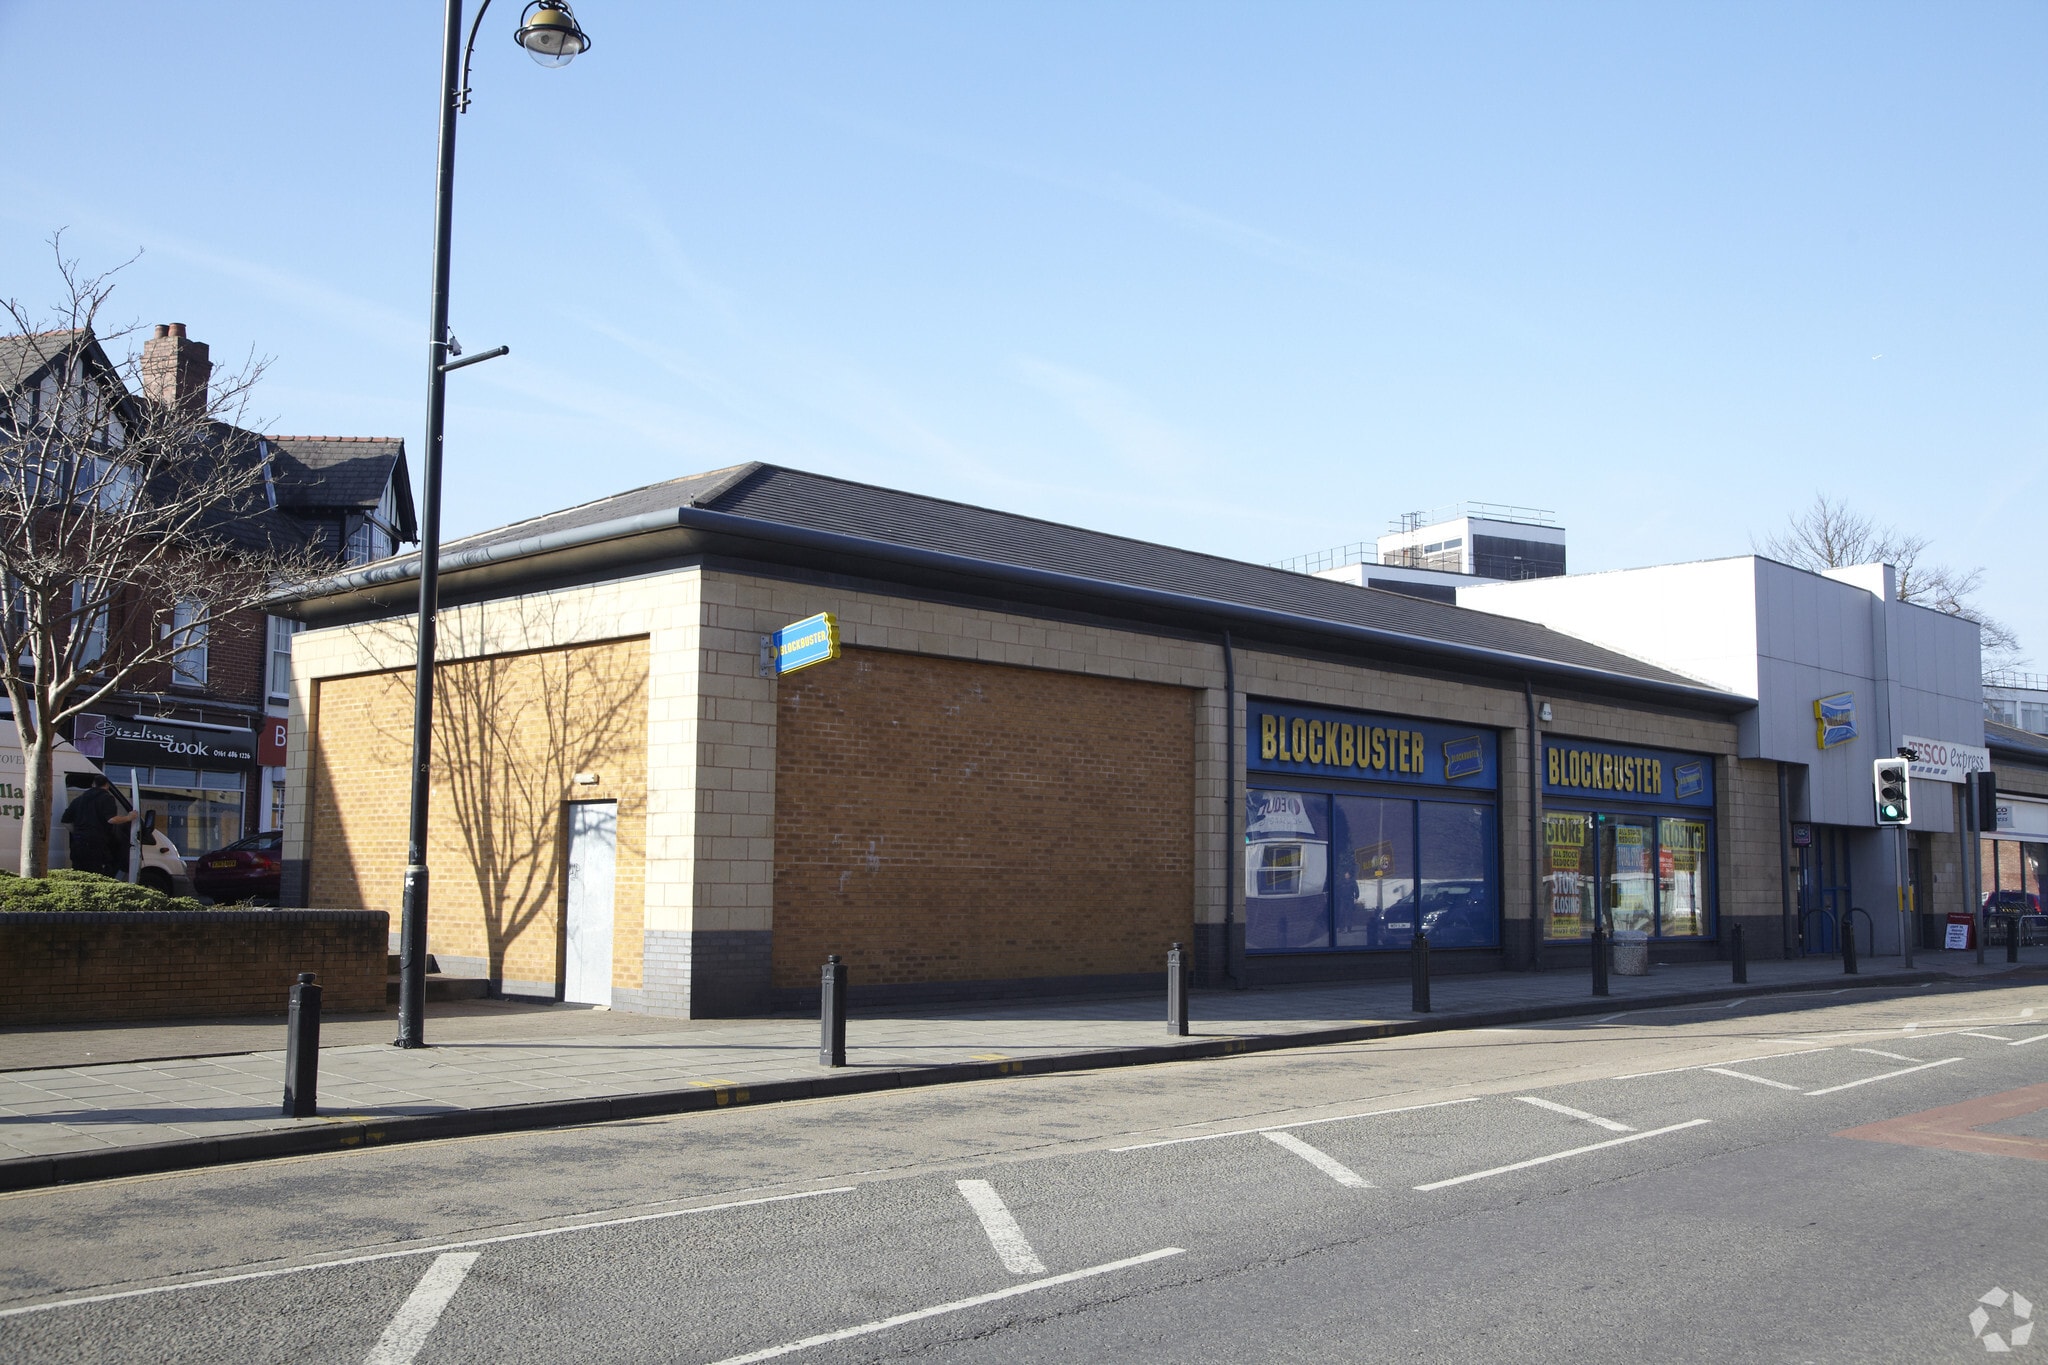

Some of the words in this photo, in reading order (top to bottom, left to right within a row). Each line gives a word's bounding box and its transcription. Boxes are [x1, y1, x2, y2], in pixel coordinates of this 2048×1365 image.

[780, 630, 827, 655] BLOCKBUSTER
[84, 720, 175, 748] Sizzling
[1261, 713, 1425, 774] BLOCKBUSTER
[1548, 747, 1662, 794] BLOCKBUSTER
[1950, 748, 1984, 775] express
[1547, 817, 1581, 844] STORE
[1663, 822, 1704, 850] CLOSING!
[1552, 871, 1580, 895] STORE
[1553, 896, 1580, 914] CLOSING
